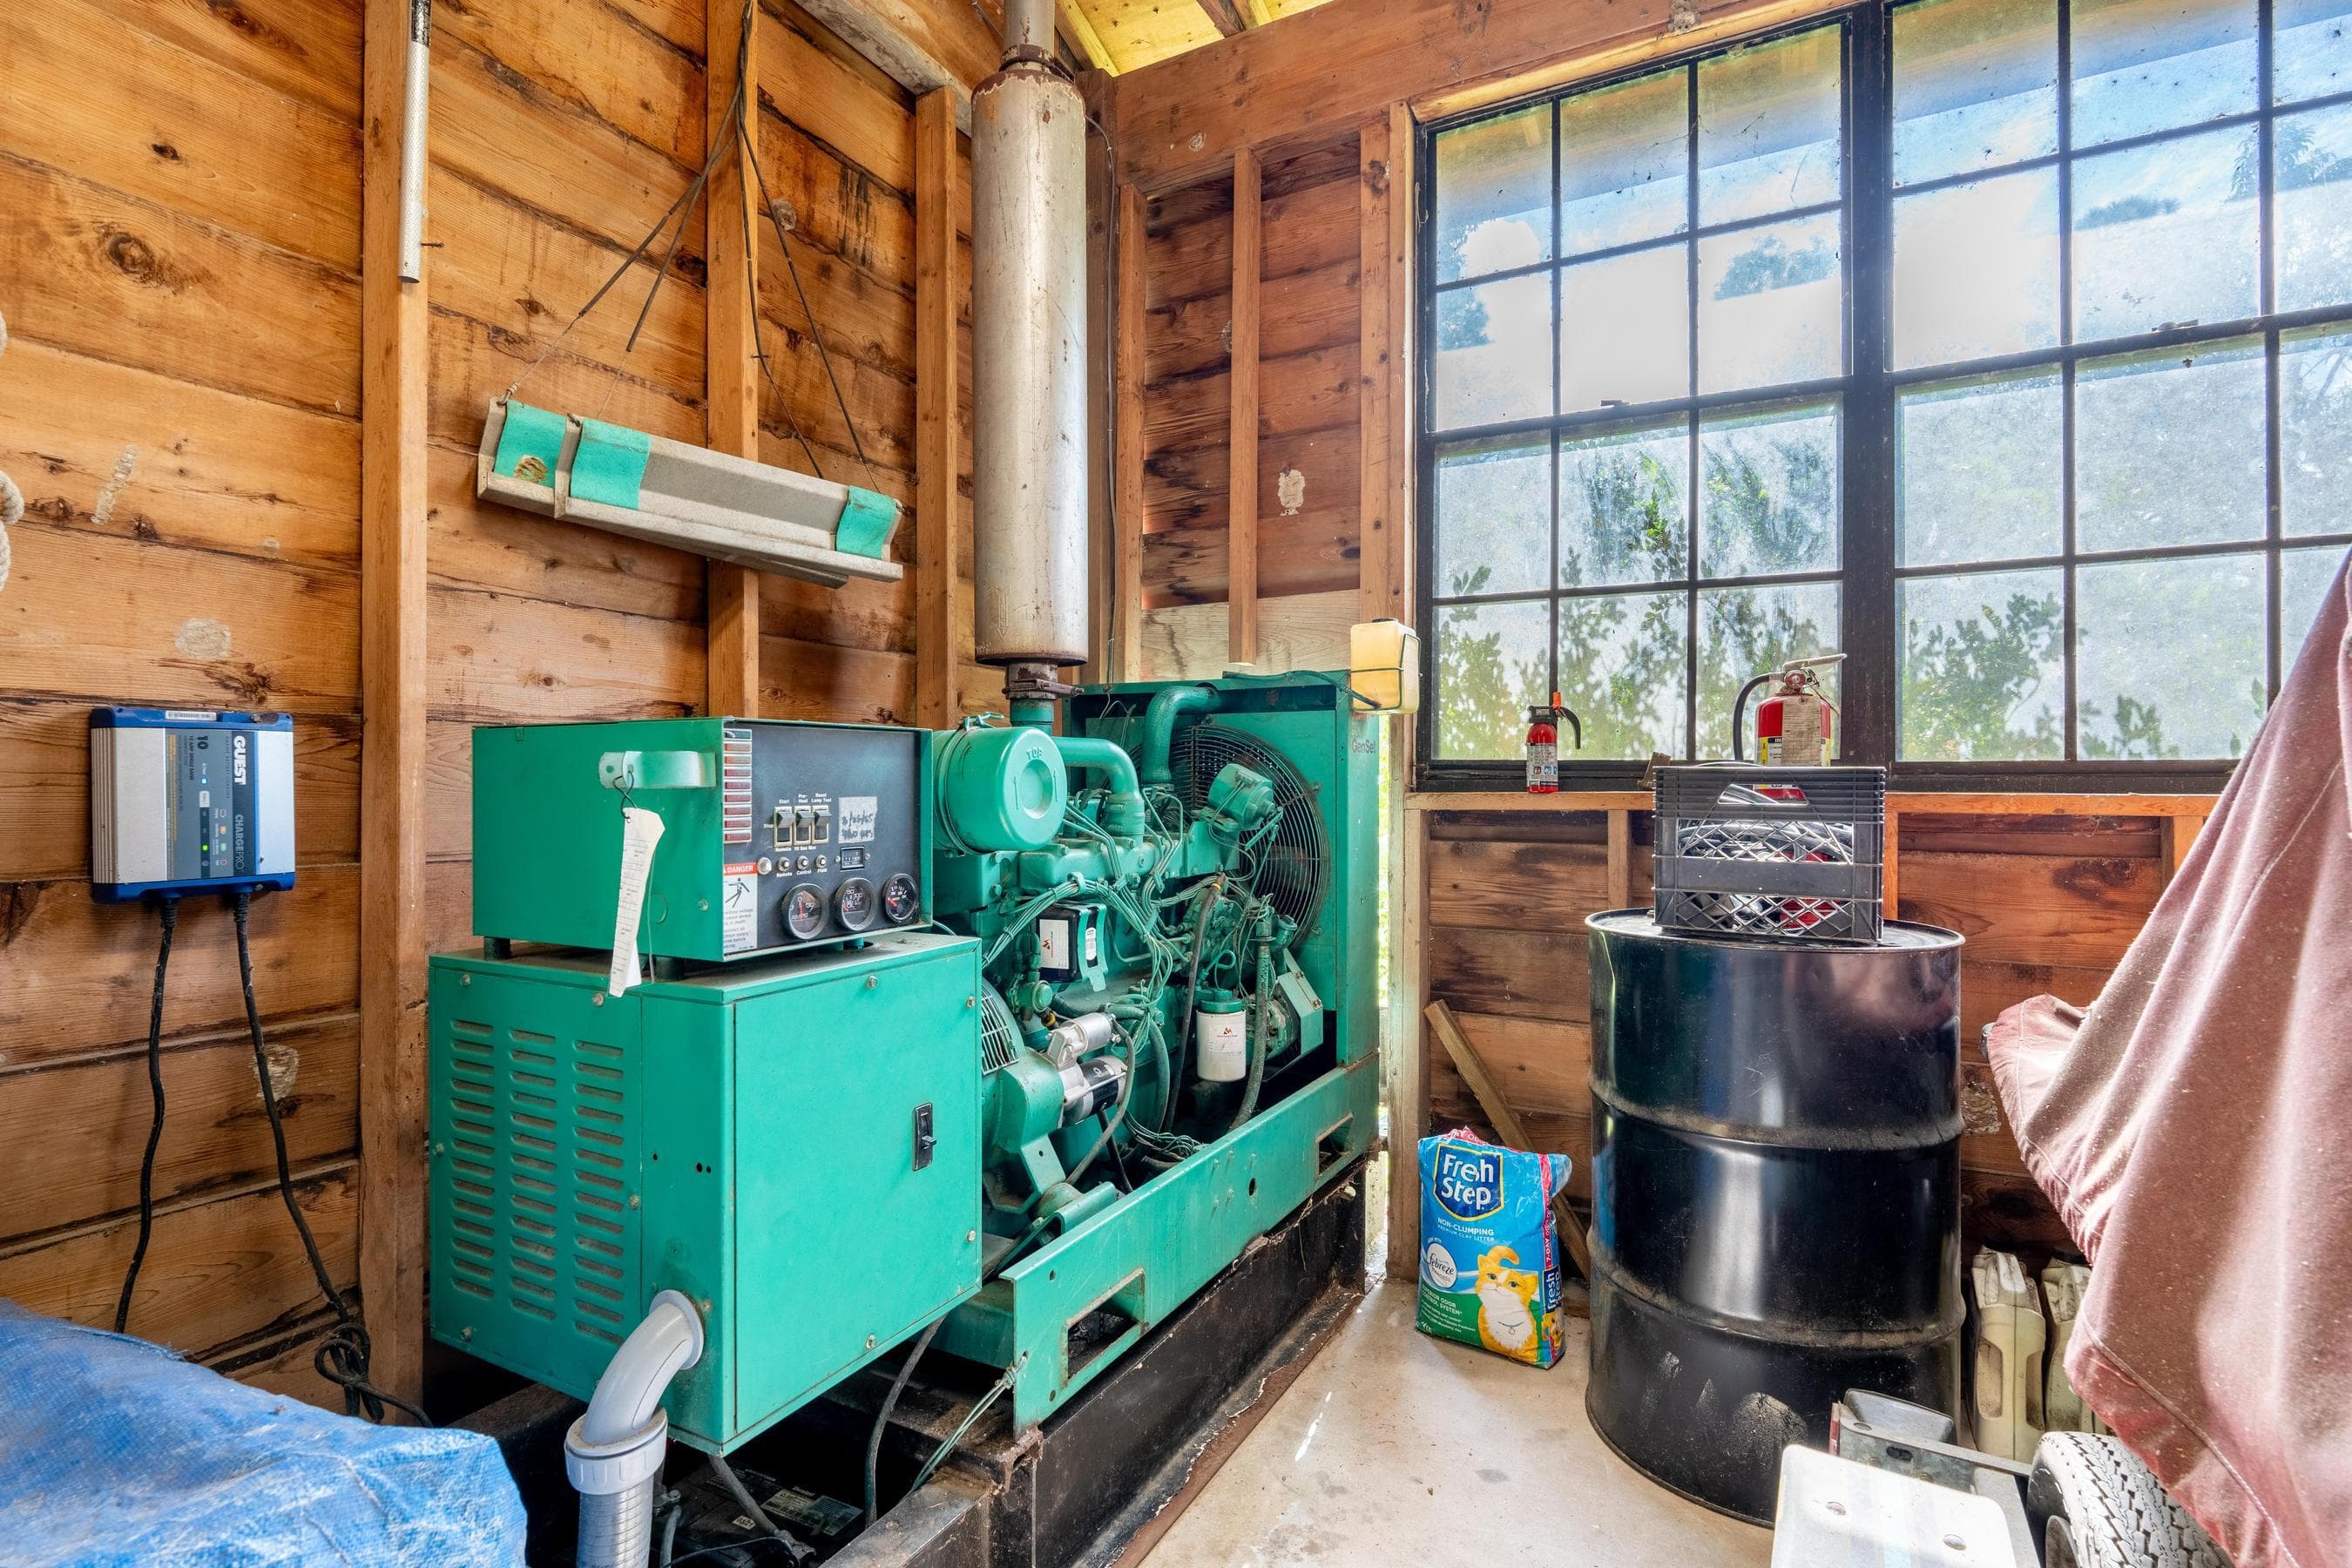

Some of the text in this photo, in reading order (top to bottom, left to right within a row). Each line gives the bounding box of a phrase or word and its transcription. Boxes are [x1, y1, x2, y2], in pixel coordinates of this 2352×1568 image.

[197, 735, 208, 750] 10
[233, 735, 247, 785] GUEST
[1025, 747, 1043, 760] TOP
[234, 814, 245, 869] CHARGEPRO
[727, 865, 754, 874] DANGER
[1443, 1153, 1494, 1183] Freh
[1441, 1177, 1491, 1210] Step
[1437, 1217, 1495, 1237] NON-CLUMPING
[1437, 1224, 1457, 1235] PREMIUM
[1429, 1253, 1455, 1275] febreze
[1440, 1297, 1456, 1308] ODOR
